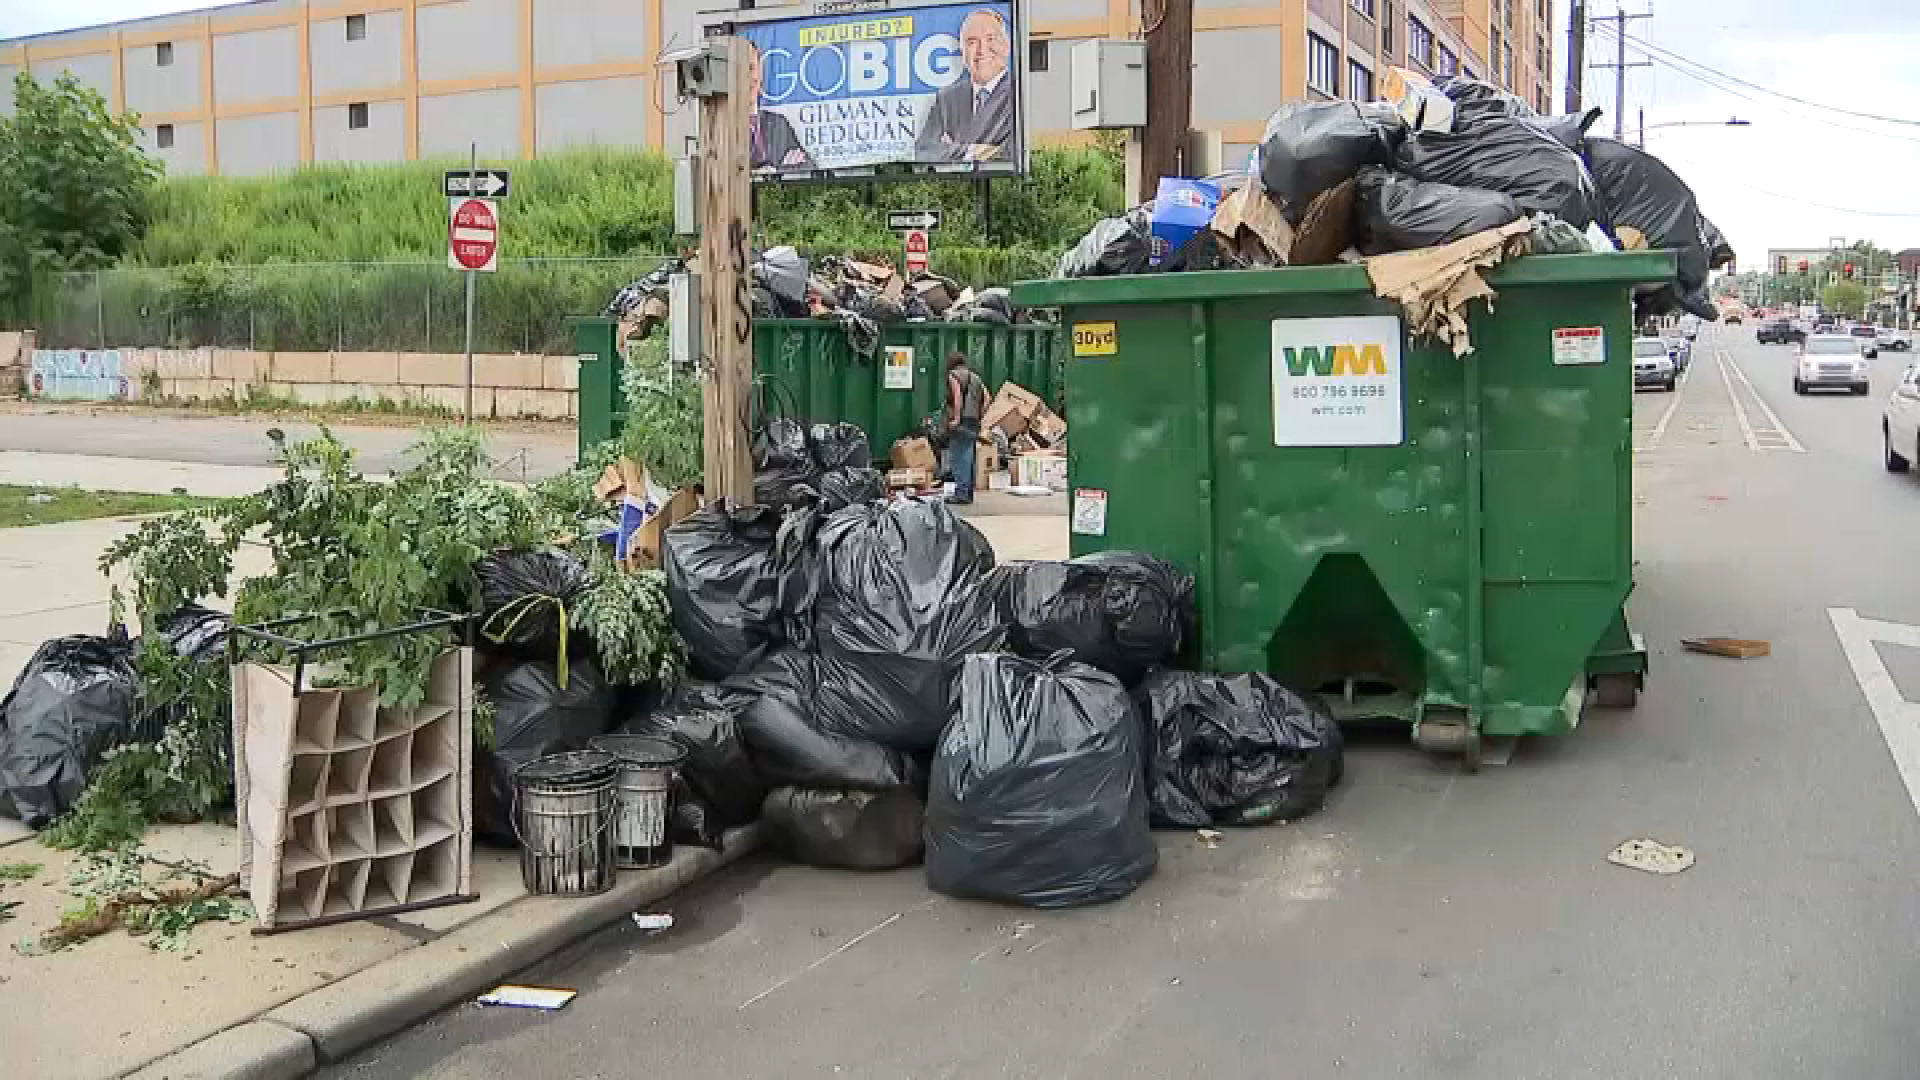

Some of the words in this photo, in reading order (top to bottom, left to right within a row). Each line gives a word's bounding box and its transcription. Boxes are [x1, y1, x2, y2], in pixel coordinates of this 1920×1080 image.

[807, 19, 904, 44] INJURED?
[799, 99, 887, 125] GILMAN
[896, 98, 915, 118] &
[804, 119, 916, 146] BEDIGIAN
[1283, 344, 1387, 376] WM
